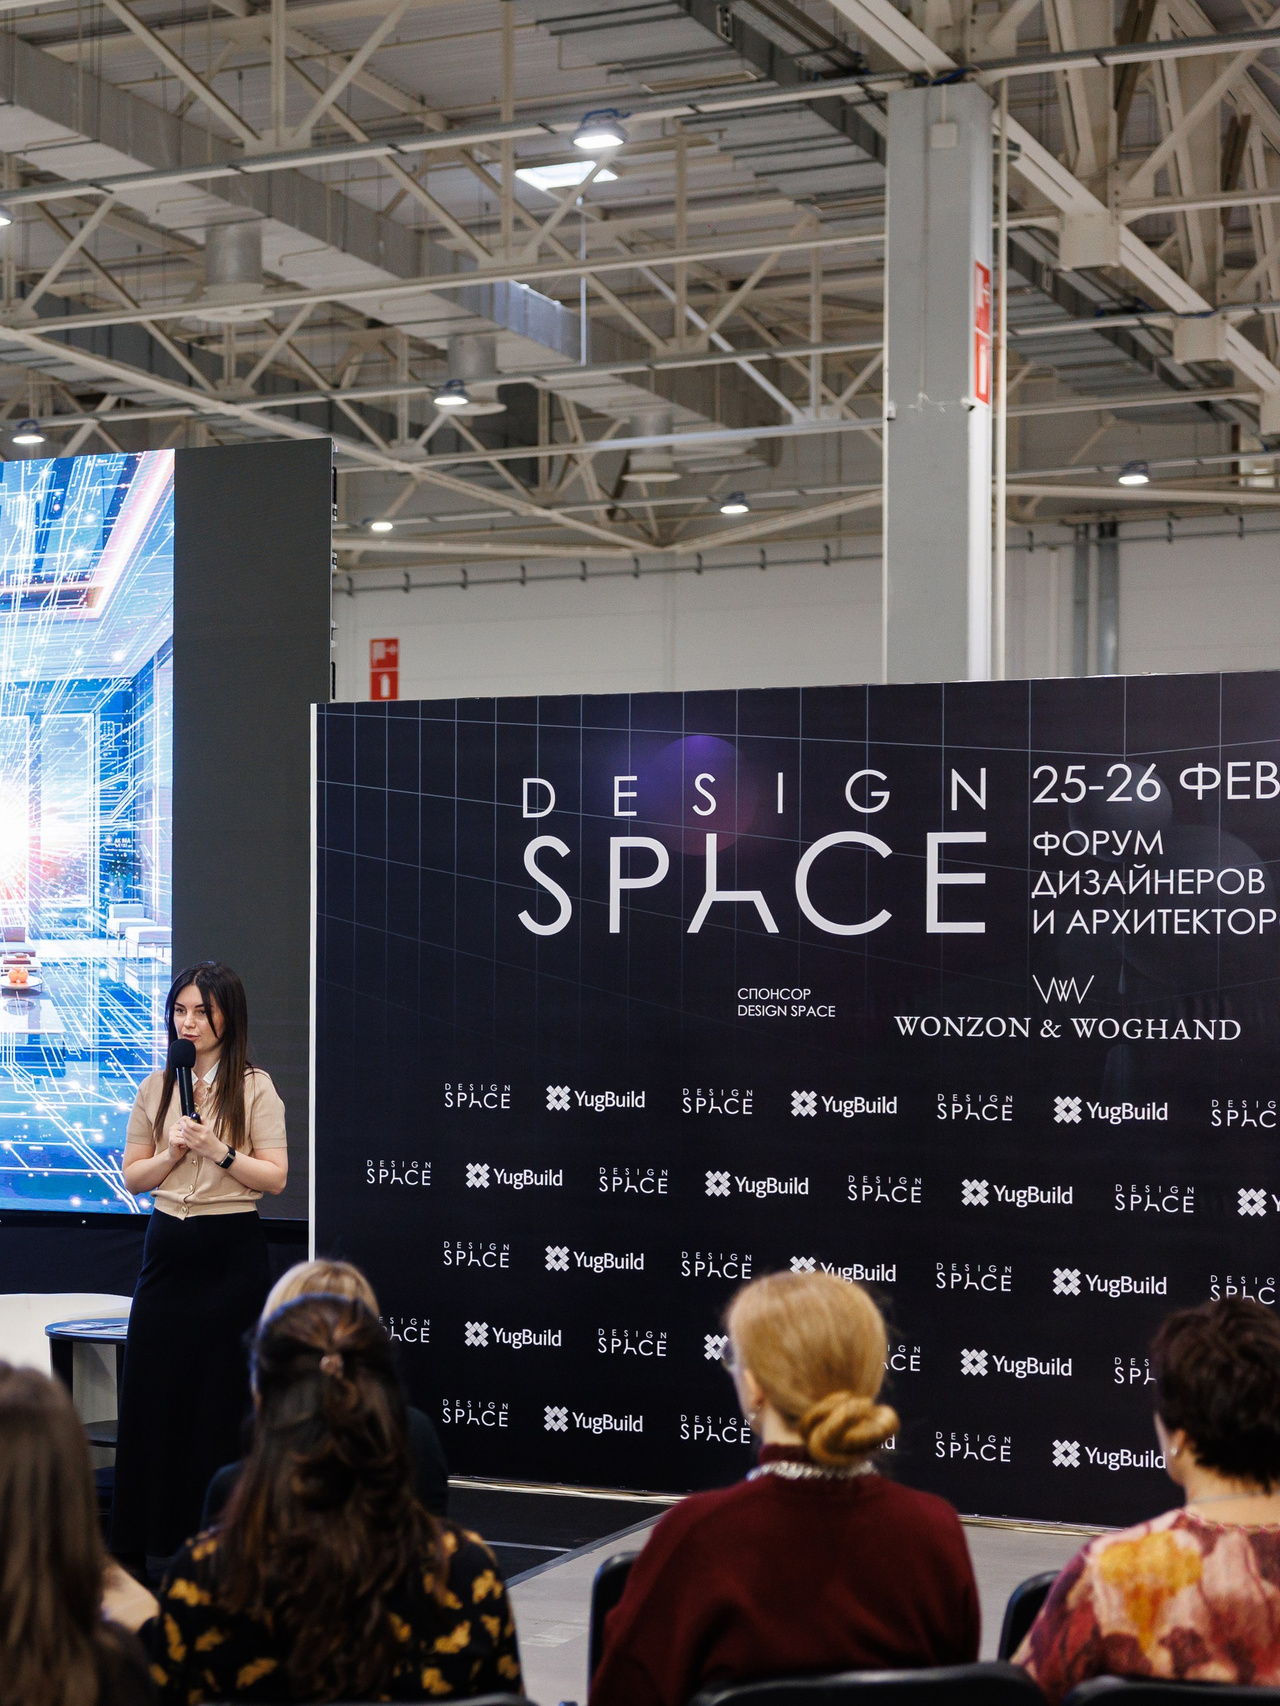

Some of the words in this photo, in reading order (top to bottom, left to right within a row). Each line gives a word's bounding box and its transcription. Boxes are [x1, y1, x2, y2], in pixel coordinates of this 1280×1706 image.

[1033, 763, 1161, 803] 25-26
[1180, 761, 1280, 800] ФЕВ
[523, 768, 986, 818] DESIGN
[1033, 830, 1163, 856] ФОРУМ
[518, 831, 986, 935] SPACE
[1032, 864, 1265, 898] ДИЗАЙНЕРОВ
[1034, 910, 1054, 934] И
[1066, 909, 1276, 934] АРХИТЕКТОР
[738, 988, 811, 1000] СПОНСОР
[738, 1005, 786, 1016] DESIGN
[791, 1005, 835, 1017] SPACE
[894, 1016, 1031, 1037] WONZON
[1040, 1020, 1061, 1038] &
[1071, 1018, 1241, 1040] WOGHAND
[445, 1083, 510, 1091] DESIGN
[683, 1088, 752, 1098] DESIGN
[445, 1092, 510, 1108] SPACE
[575, 1091, 645, 1112] YugBuild
[683, 1098, 752, 1114] SPACE
[822, 1096, 897, 1117] YugBuild
[938, 1094, 1012, 1102] DESIGN
[937, 1103, 1012, 1121] SPACE
[1086, 1102, 1167, 1124] YugBuild
[367, 1160, 431, 1168] DESIGN
[600, 1167, 667, 1177] DESIGN
[367, 1169, 430, 1185] SPACE
[494, 1169, 562, 1189] YugBuild
[599, 1177, 667, 1193] SPACE
[849, 1175, 921, 1184] DESIGN
[735, 1177, 808, 1198] YugBuild
[848, 1185, 921, 1203] SPACE
[994, 1185, 1072, 1207] YugBuild
[1116, 1184, 1194, 1193] DESIGN
[1115, 1194, 1194, 1213] SPACE
[444, 1241, 509, 1250] DESIGN
[444, 1250, 509, 1268] SPACE
[574, 1252, 644, 1273] YugBuild
[682, 1252, 751, 1261] DESIGN
[682, 1261, 751, 1279] SPACE
[820, 1262, 896, 1284] YugBuild
[937, 1263, 1011, 1273] DESIGN
[936, 1272, 1011, 1291] SPACE
[1086, 1274, 1166, 1297] YugBuild
[493, 1327, 561, 1349] YugBuild
[598, 1329, 666, 1338] DESIGN
[598, 1338, 666, 1356] SPACE
[993, 1355, 1072, 1378] YugBuild
[443, 1399, 508, 1409] DESIGN
[443, 1408, 508, 1427] SPACE
[572, 1412, 642, 1434] YugBuild
[680, 1414, 751, 1425] DESIGN
[680, 1423, 751, 1444] SPACE
[936, 1432, 1010, 1442] DESIGN
[936, 1441, 1010, 1462] SPACE
[1085, 1445, 1166, 1470] YugBuild
